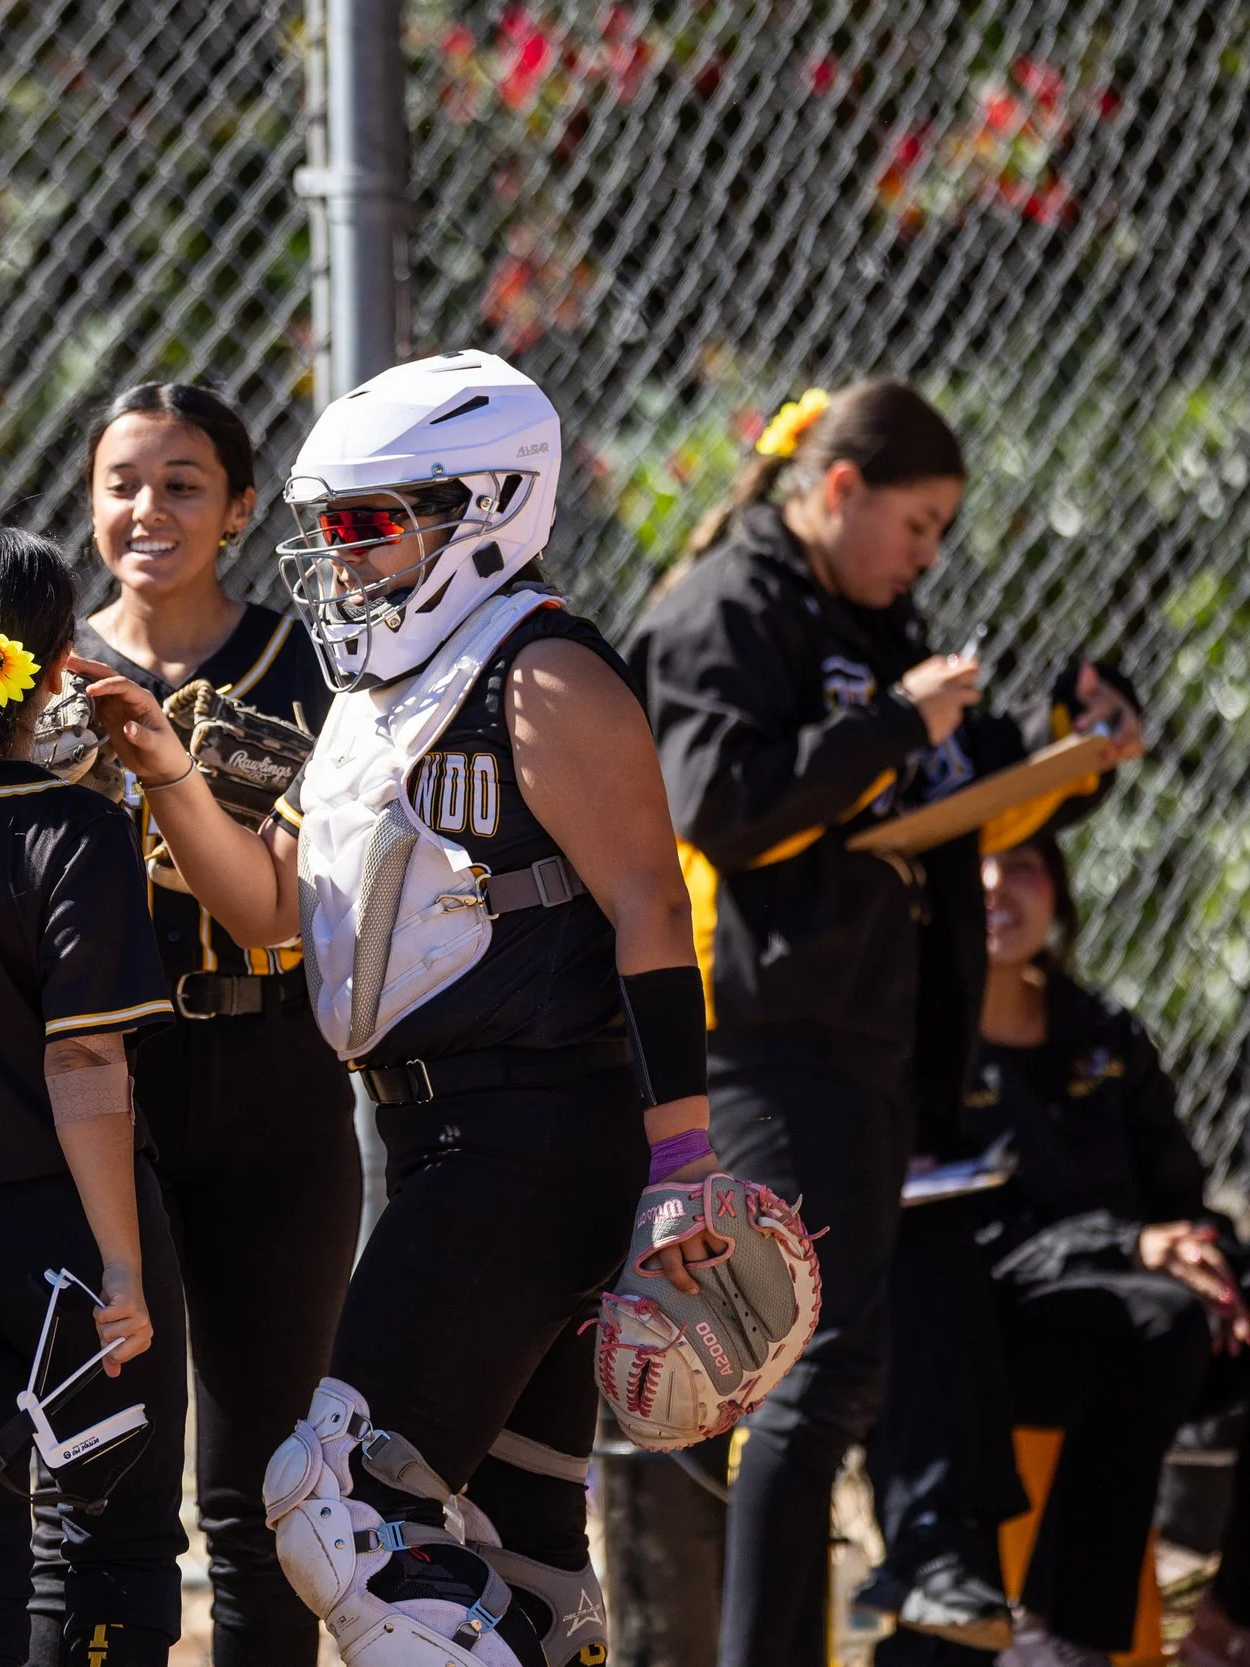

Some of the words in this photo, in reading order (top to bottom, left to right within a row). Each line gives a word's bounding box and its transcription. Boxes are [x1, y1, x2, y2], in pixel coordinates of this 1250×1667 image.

[229, 750, 292, 783] Rawlings
[637, 1198, 687, 1229] Wilson
[695, 1321, 734, 1376] A2000
